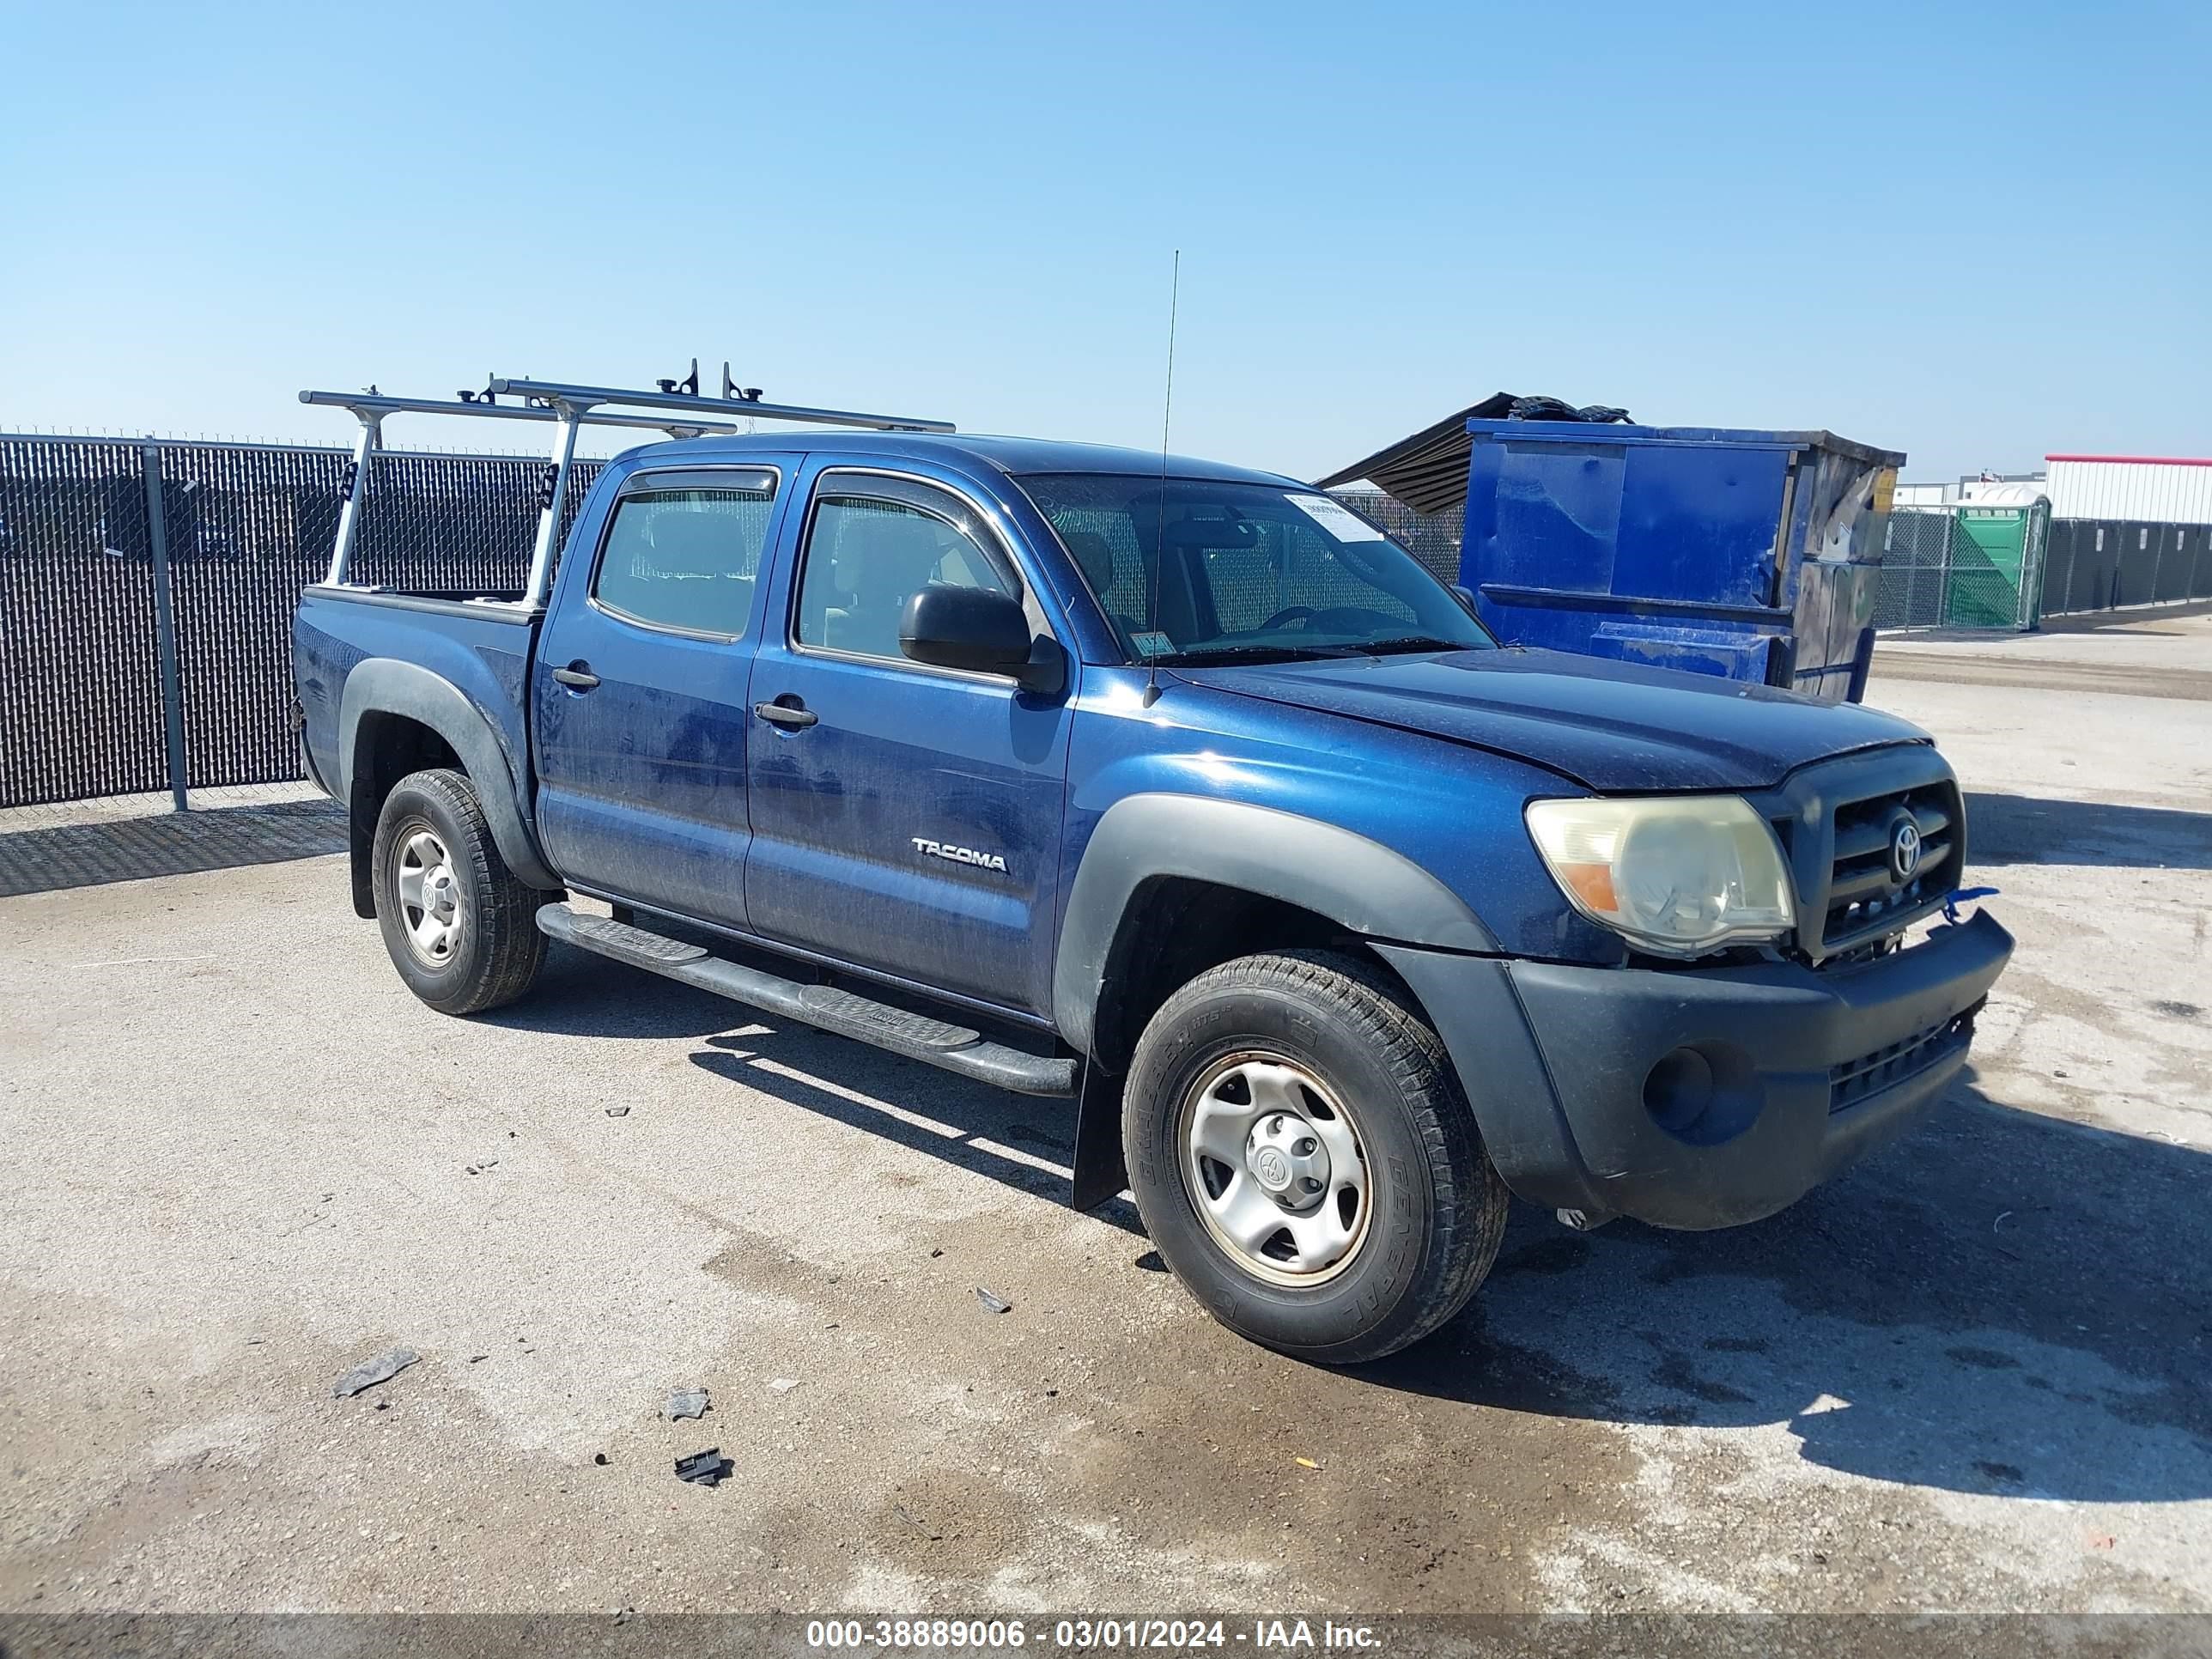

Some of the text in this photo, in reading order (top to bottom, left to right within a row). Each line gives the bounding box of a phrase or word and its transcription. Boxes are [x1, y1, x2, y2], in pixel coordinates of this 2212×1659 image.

[911, 837, 1007, 872] TACOMA
[1134, 1025, 1194, 1186] GRABBER
[1343, 1155, 1412, 1323] GENERAL
